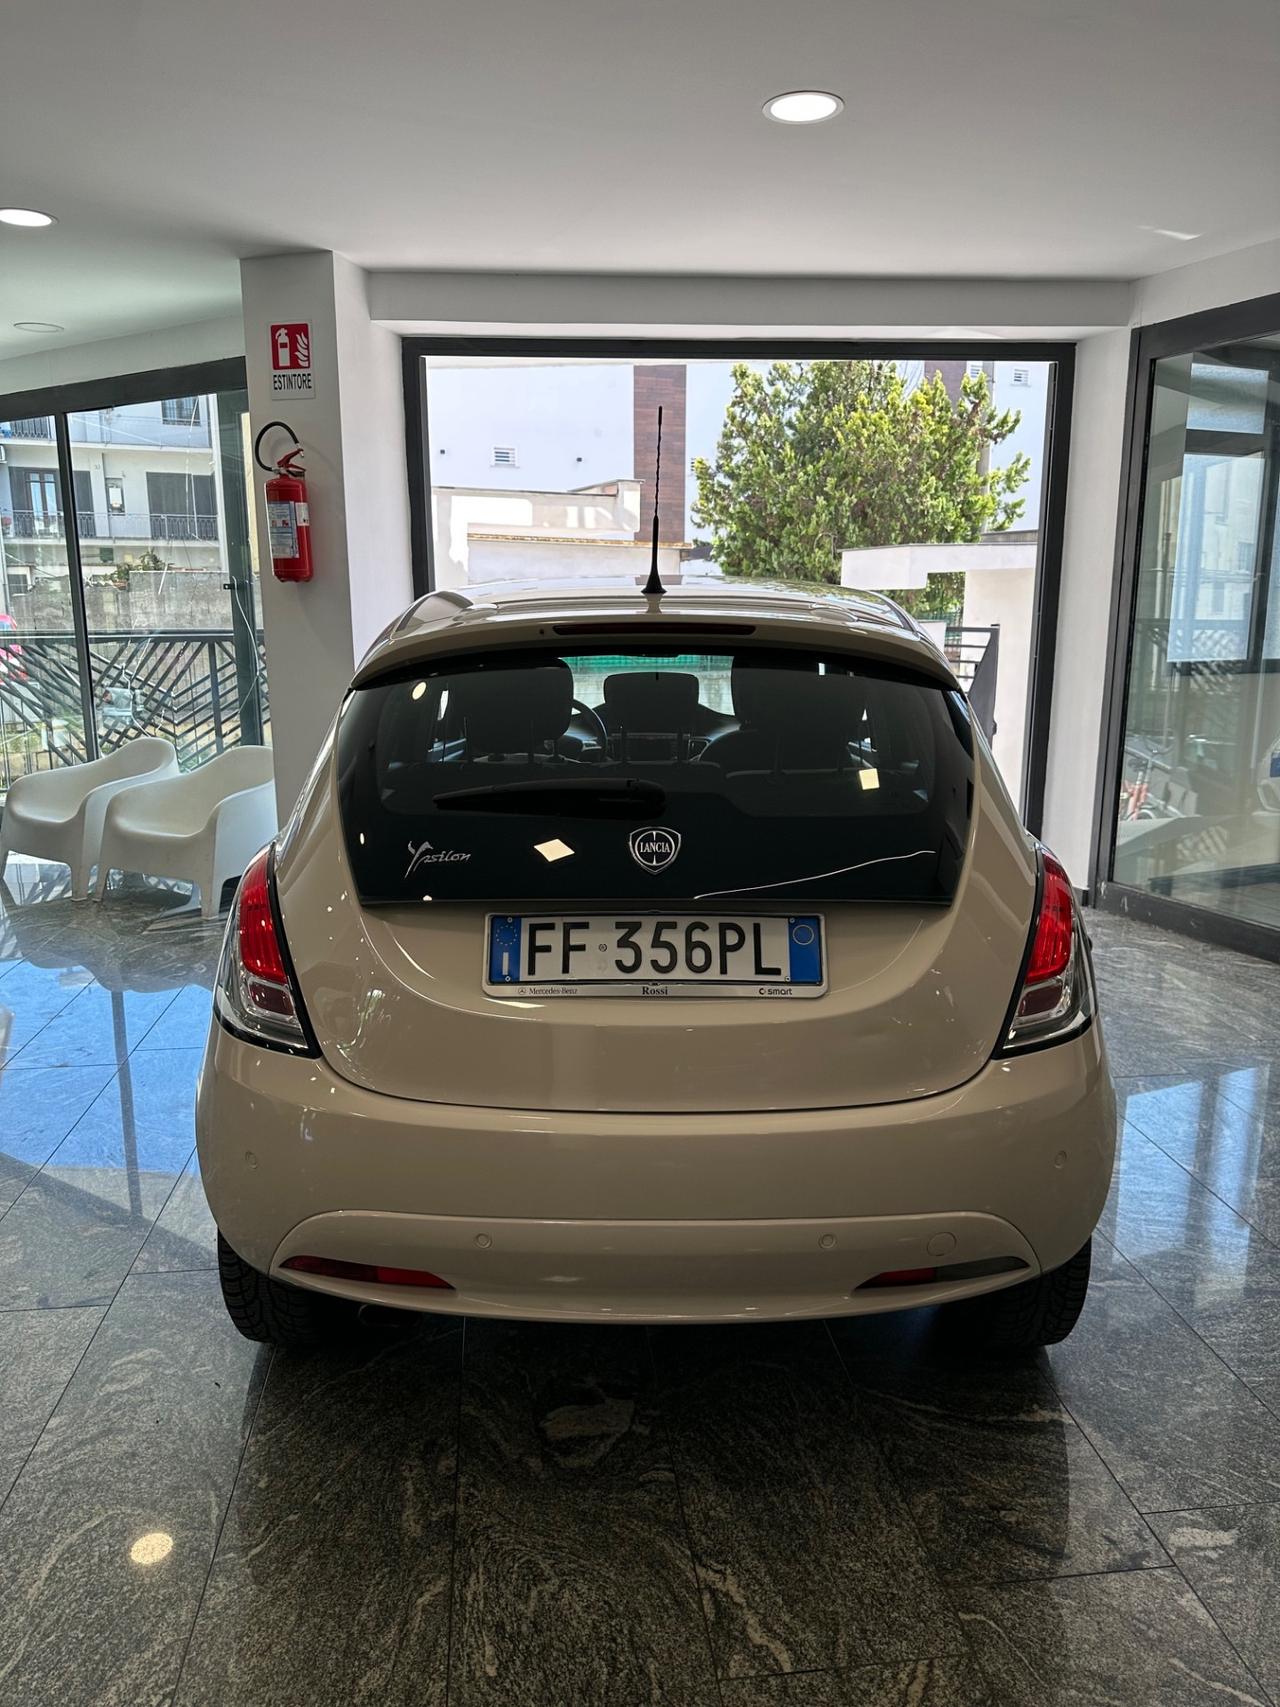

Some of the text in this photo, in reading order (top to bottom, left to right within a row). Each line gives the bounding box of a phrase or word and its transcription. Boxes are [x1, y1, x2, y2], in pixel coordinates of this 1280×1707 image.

[273, 373, 312, 390] ESTINTORE
[640, 842, 670, 853] LANCIA
[404, 841, 471, 878] Ypsilon
[527, 921, 782, 976] FF 356PL
[528, 987, 578, 995] Mercedes-Benz
[642, 986, 668, 996] Rossi
[767, 988, 793, 996] smart
